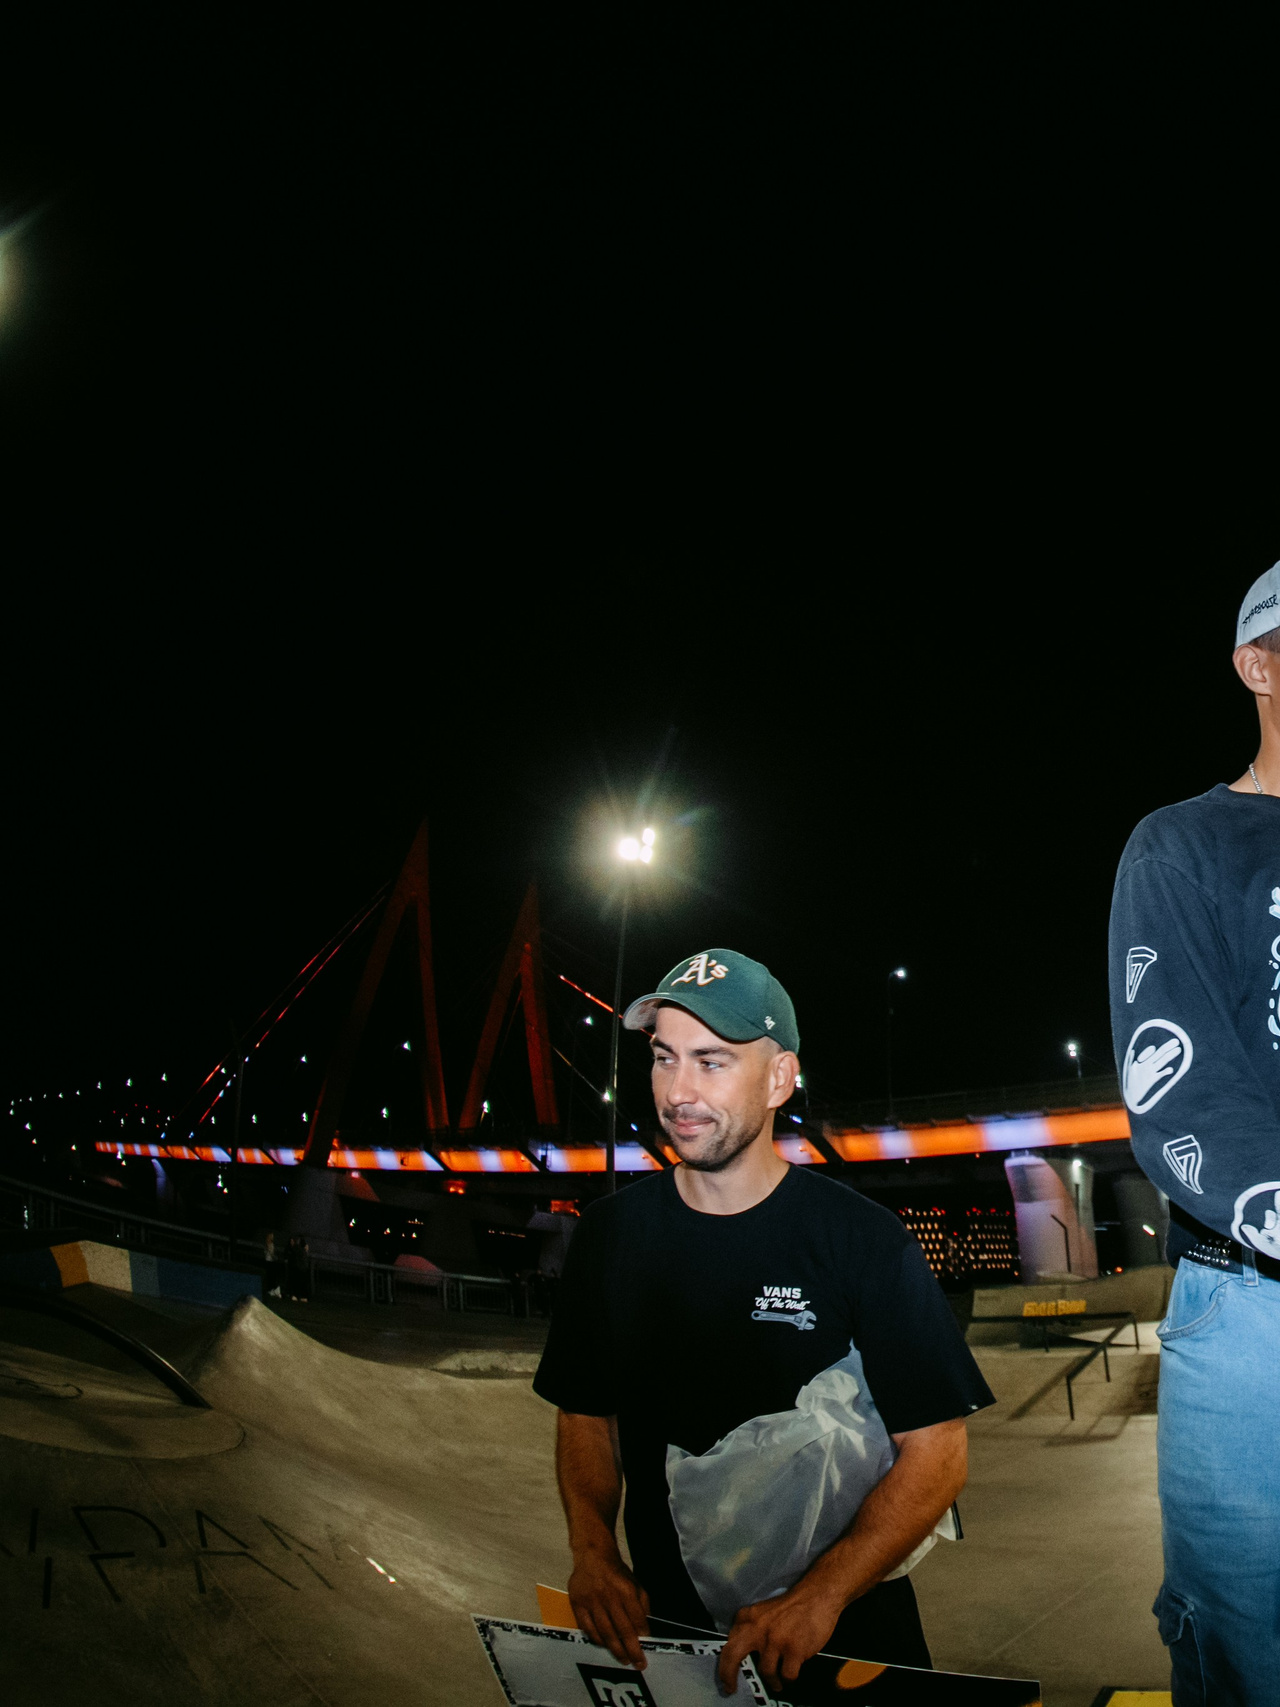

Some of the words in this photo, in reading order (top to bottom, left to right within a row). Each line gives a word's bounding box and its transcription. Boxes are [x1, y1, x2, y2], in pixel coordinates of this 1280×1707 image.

[671, 954, 728, 986] A's
[763, 1286, 801, 1299] VANS
[770, 1298, 785, 1308] The
